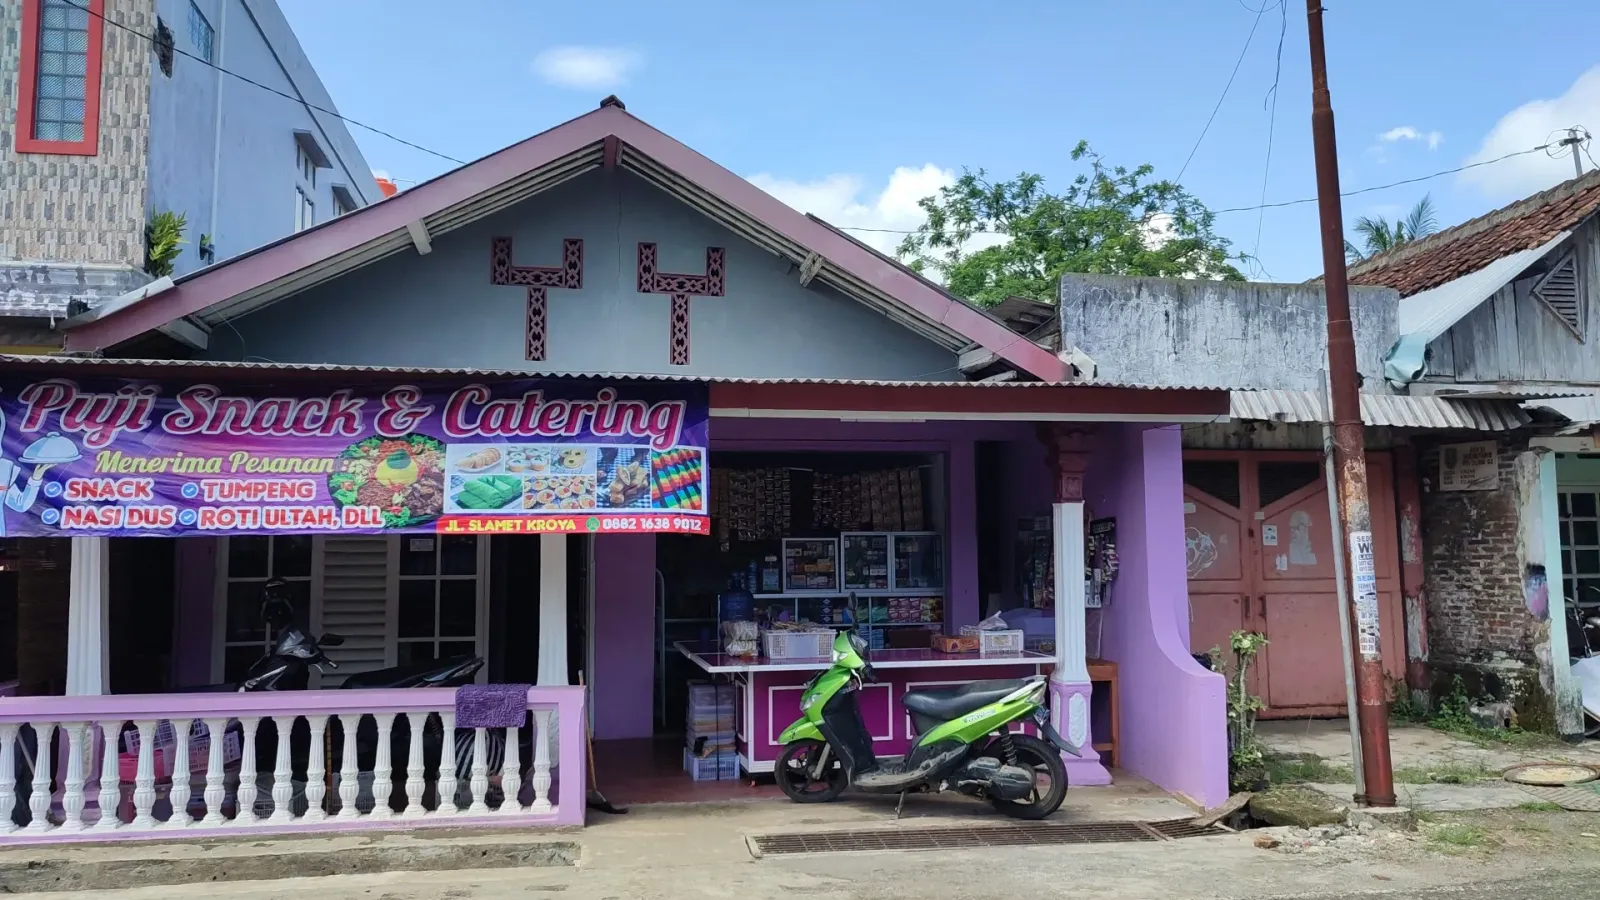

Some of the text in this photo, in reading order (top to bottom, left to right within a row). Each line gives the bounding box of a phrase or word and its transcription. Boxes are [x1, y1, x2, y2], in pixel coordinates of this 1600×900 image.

[18, 379, 686, 450] Puji Snack & Catering
[94, 450, 222, 473] Menerima
[229, 451, 334, 474] Pesanan
[66, 480, 152, 499] SNACK
[202, 481, 314, 499] TUMPENG
[62, 507, 175, 526] NASI DUS
[199, 508, 383, 527] ROTI ULTAH, DLL
[445, 519, 577, 531] JL. SLAMET KROYA
[602, 517, 702, 531] 0882 1638 9012
